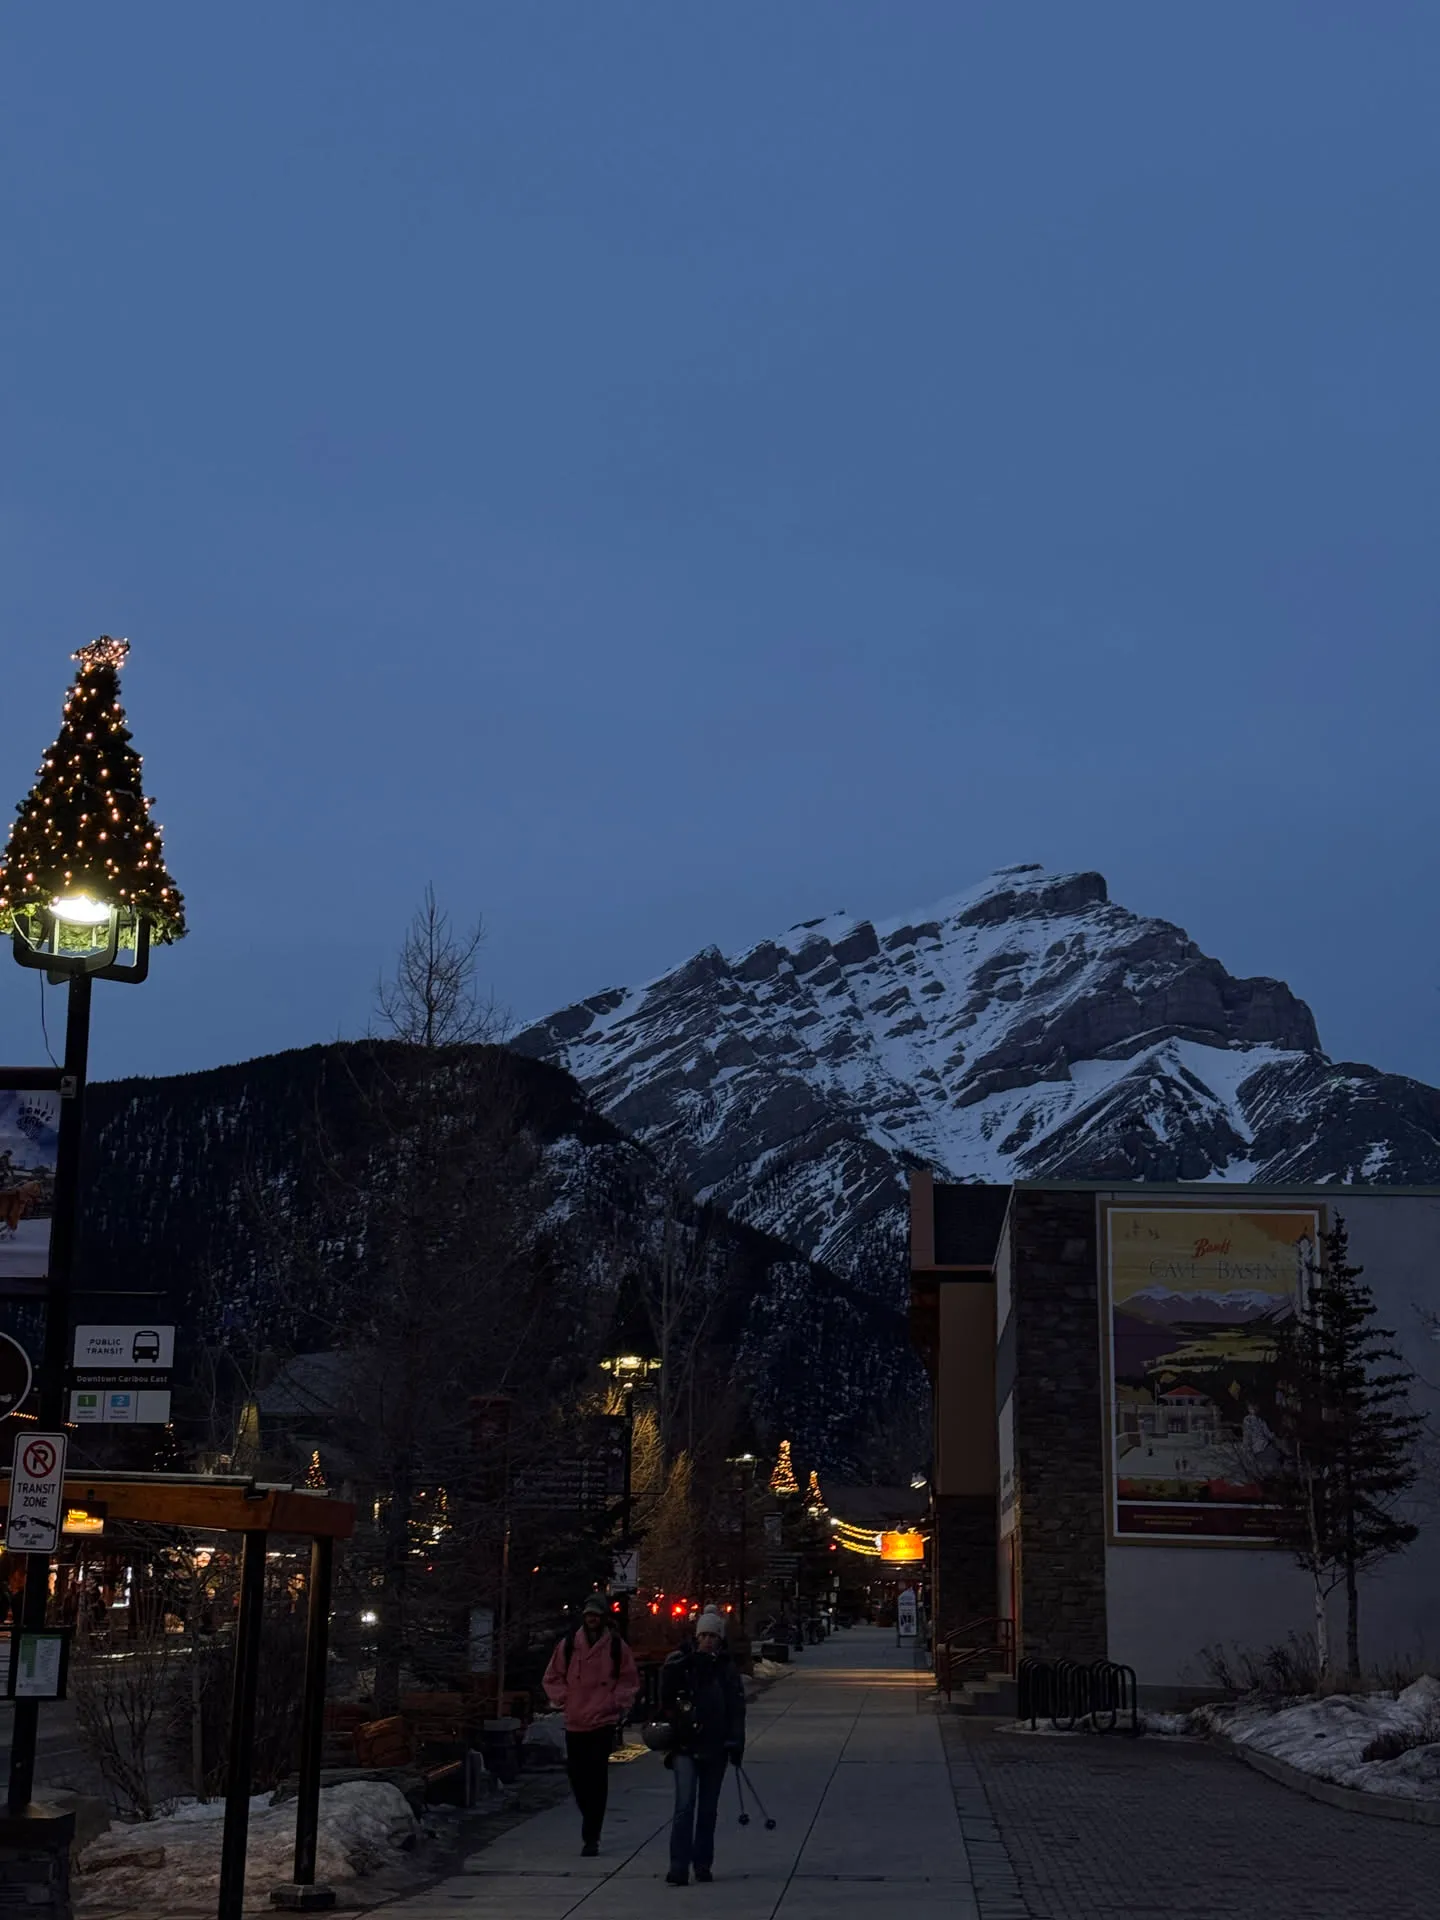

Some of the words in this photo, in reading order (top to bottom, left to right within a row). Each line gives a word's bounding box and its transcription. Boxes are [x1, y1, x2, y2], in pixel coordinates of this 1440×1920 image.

[89, 1338, 121, 1346] PUBLIC
[86, 1347, 124, 1355] TRANSIT
[76, 1375, 116, 1383] Downtown
[118, 1375, 148, 1383] Caribou
[150, 1375, 168, 1383] East
[17, 1482, 57, 1495] TRANSIT
[23, 1496, 48, 1508] ZONE
